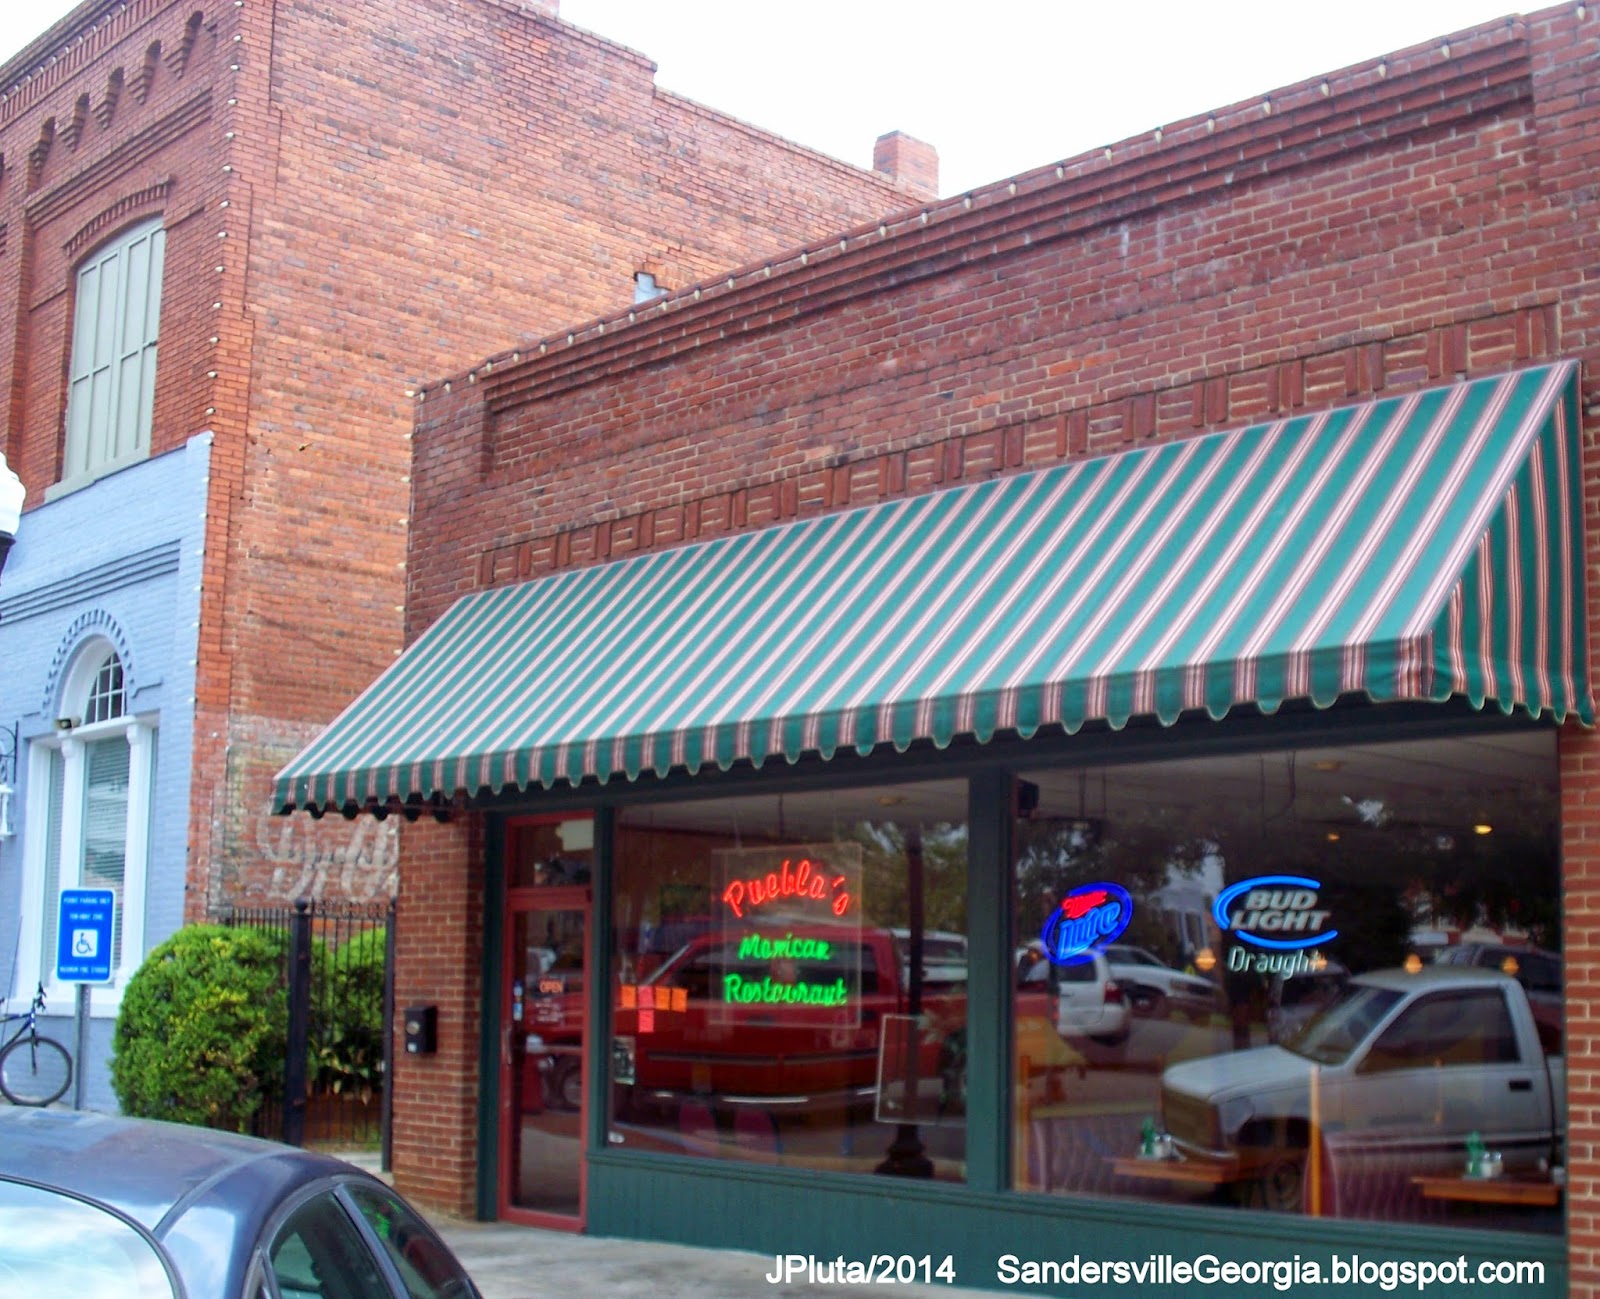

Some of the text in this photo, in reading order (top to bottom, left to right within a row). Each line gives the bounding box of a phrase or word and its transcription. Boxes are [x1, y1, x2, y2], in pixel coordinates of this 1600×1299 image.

[723, 859, 849, 917] Puebla's
[1246, 889, 1318, 911] BUD
[1230, 910, 1331, 931] LIGHT
[738, 932, 831, 960] Mexican
[1228, 945, 1321, 980] Draught
[539, 980, 564, 993] OPEN
[723, 973, 847, 1007] Restaurant
